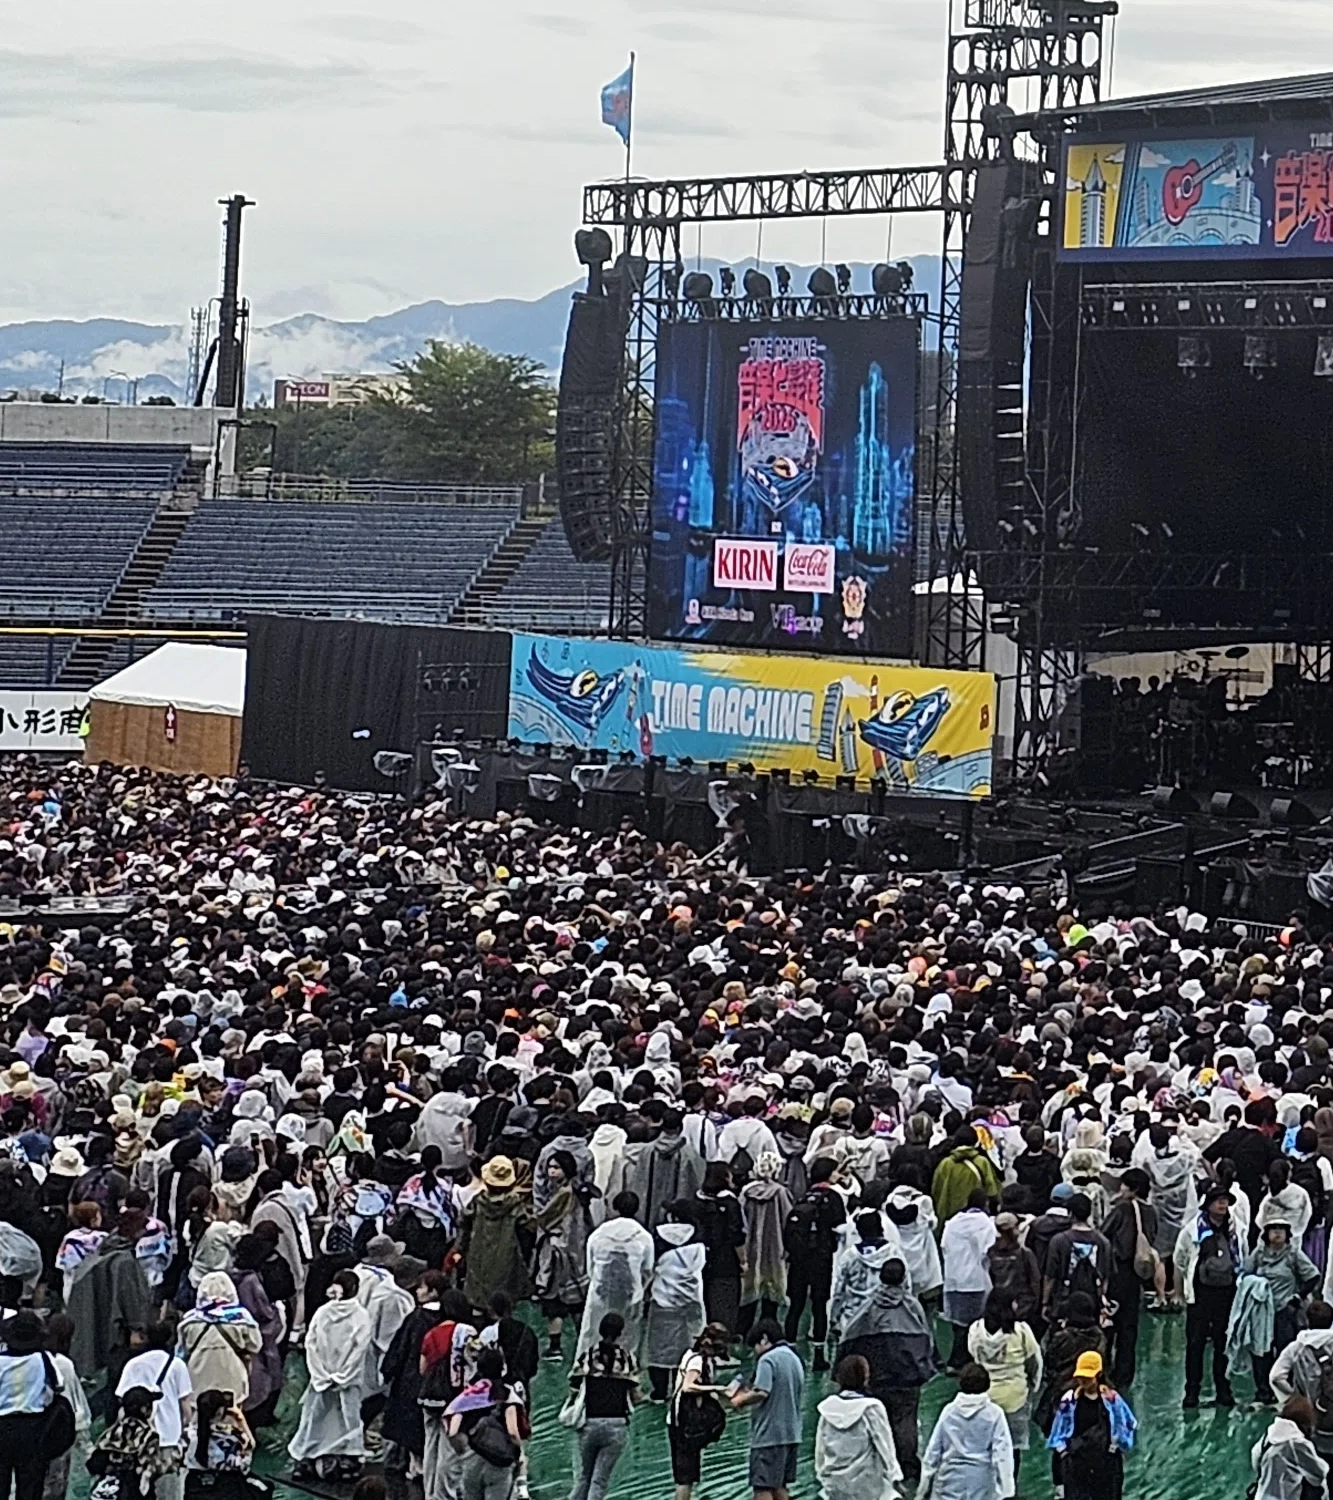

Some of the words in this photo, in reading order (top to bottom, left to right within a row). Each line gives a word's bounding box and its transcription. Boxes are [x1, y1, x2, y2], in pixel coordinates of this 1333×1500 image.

[1310, 132, 1333, 148] TIME
[718, 547, 774, 582] KIRIN
[651, 679, 703, 731] TIME
[707, 686, 814, 743] MACHINE
